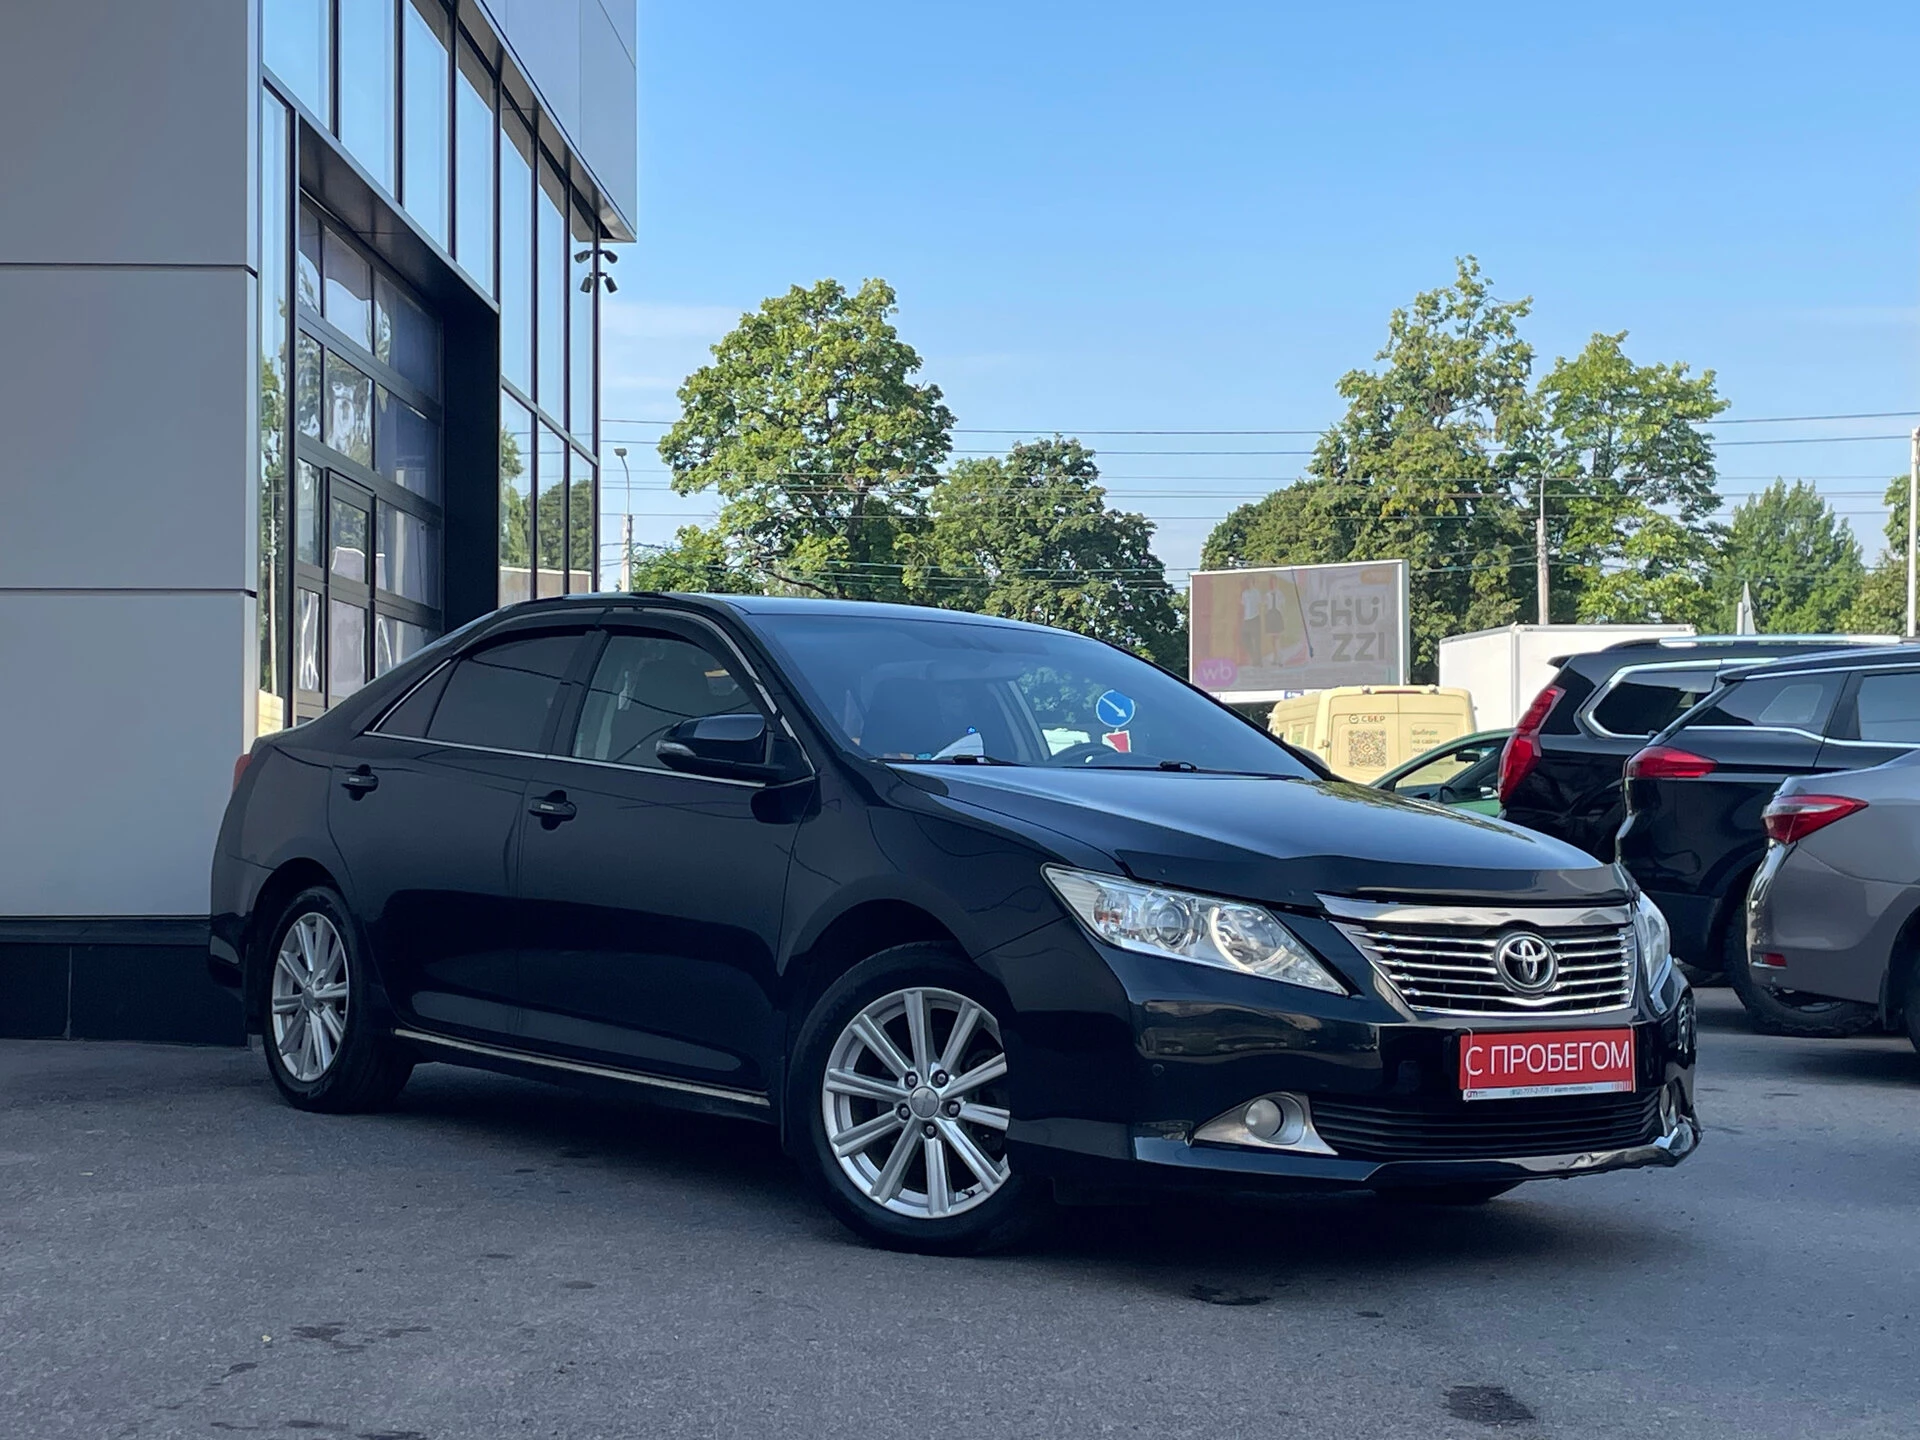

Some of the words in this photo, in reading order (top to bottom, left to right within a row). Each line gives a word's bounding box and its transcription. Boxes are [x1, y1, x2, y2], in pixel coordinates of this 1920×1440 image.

[1331, 632, 1385, 662] ZZI
[1202, 659, 1233, 681] wb
[1361, 715, 1386, 723] СБЕР
[1465, 1046, 1484, 1076] С
[1491, 1040, 1630, 1075] ПРОБЕГОМ
